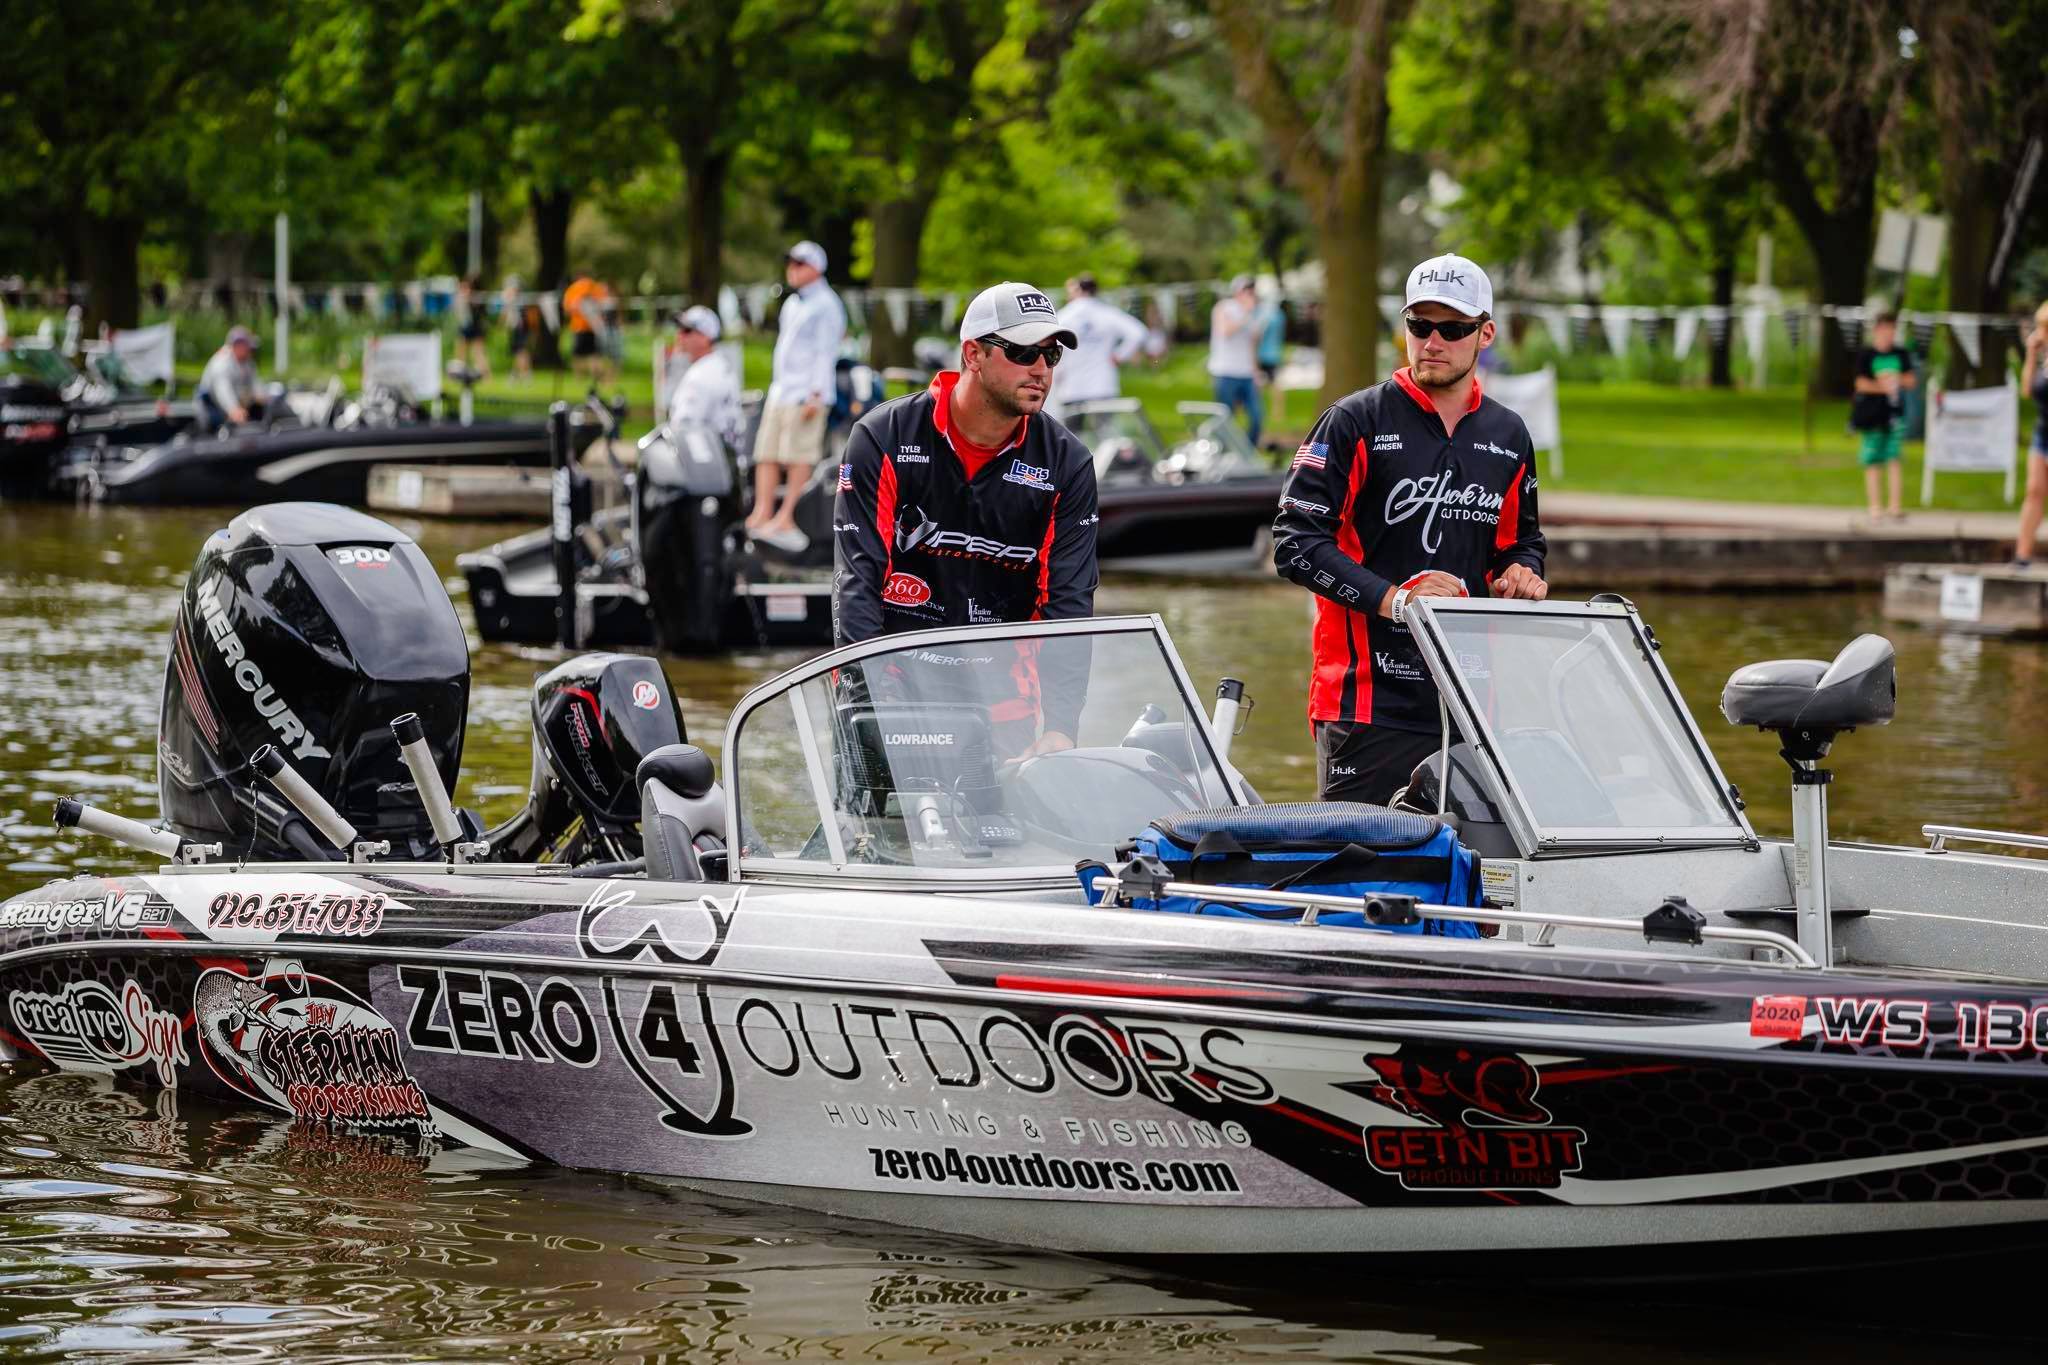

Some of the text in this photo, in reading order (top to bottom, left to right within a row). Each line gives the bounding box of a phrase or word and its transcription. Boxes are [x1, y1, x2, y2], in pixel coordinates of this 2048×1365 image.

[899, 445, 921, 454] TYLER
[1373, 443, 1403, 451] JANSEN
[1374, 434, 1400, 442] KADEN
[336, 548, 391, 565] 300
[882, 578, 921, 597] 360
[196, 577, 332, 760] MERCURY
[885, 733, 954, 746] LOWRANCE
[0, 901, 104, 932] Ranger
[141, 908, 166, 921] 621
[1755, 1006, 1801, 1022] 2020
[1816, 996, 1929, 1046] WS
[15, 984, 190, 1086] creative Sign
[396, 964, 1281, 1106] ZERO 4 OUTDOORS
[258, 1024, 403, 1090] STEPHAN
[287, 1083, 428, 1119] SPORTFISHING
[419, 1123, 442, 1138] LLC
[825, 1104, 1251, 1147] HUNTING & FISHING
[1496, 1132, 1578, 1169] BIT
[868, 1147, 1243, 1194] zero4outdoors.com
[1406, 1169, 1555, 1185] PRODUCTIONS
